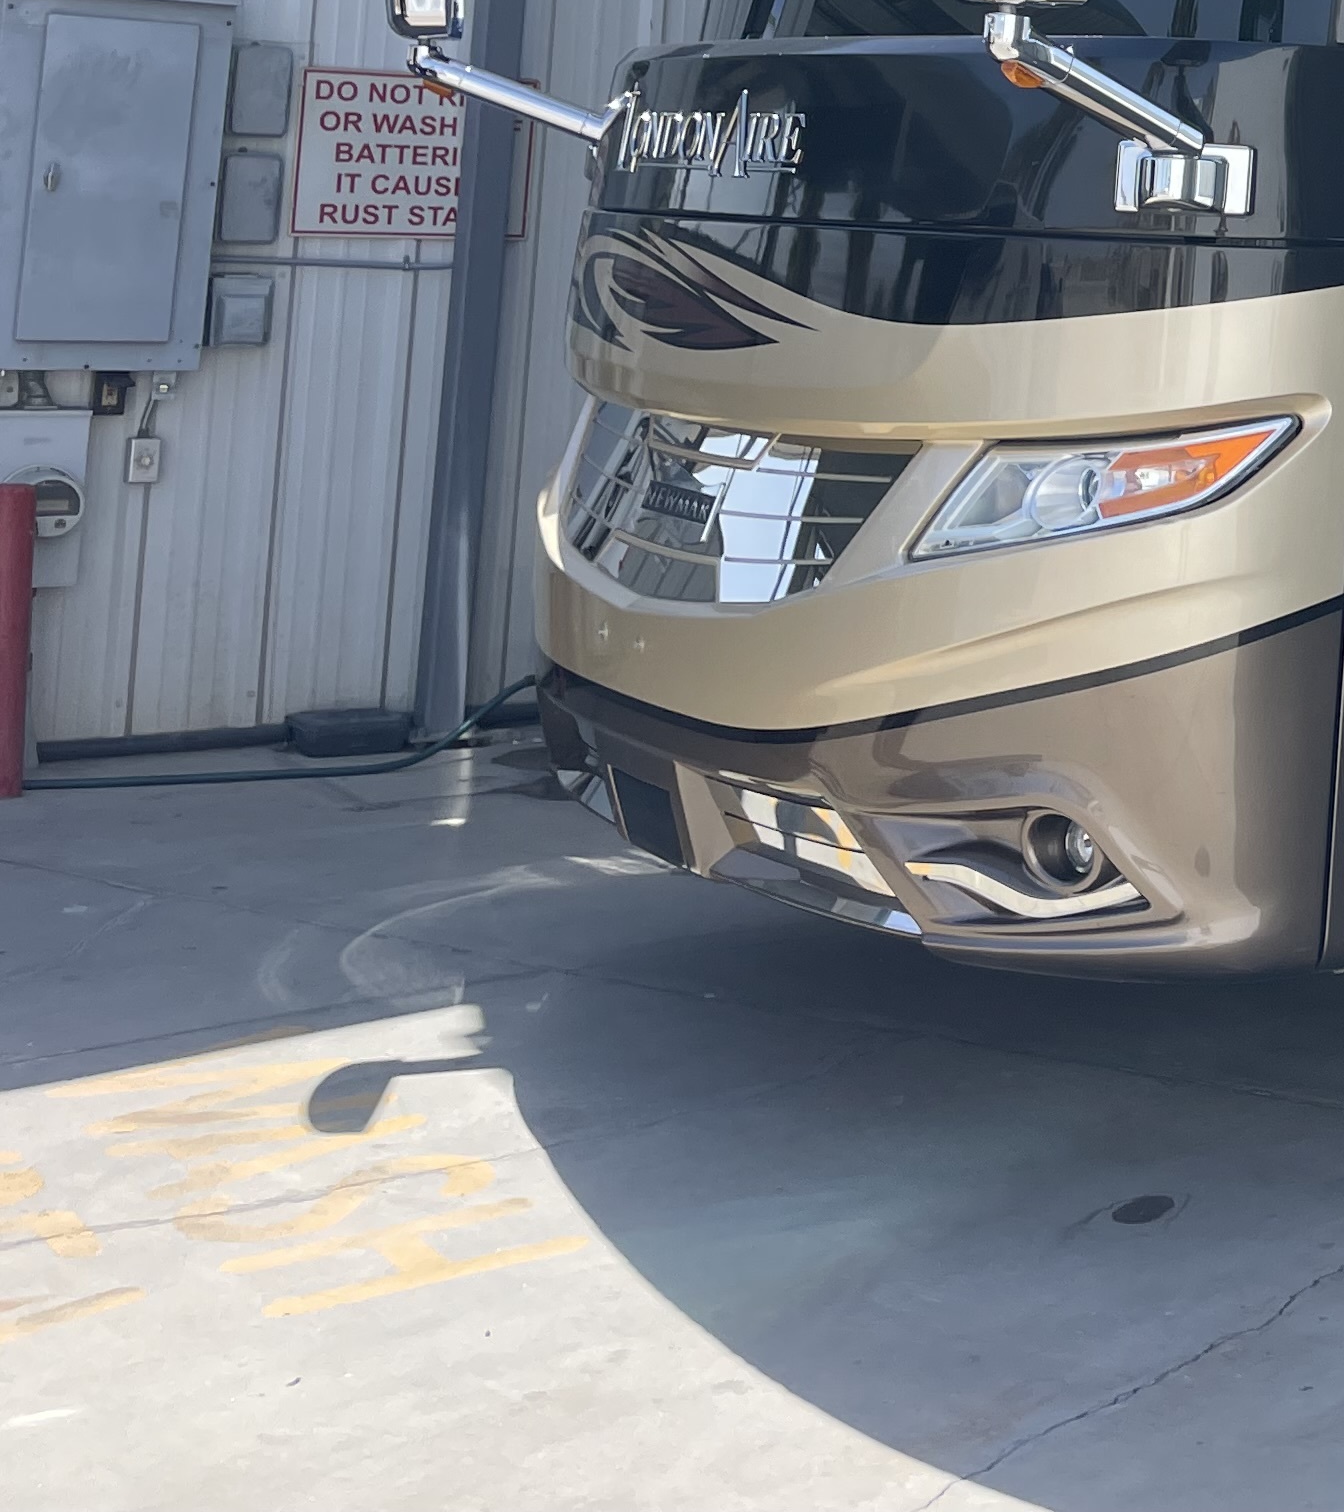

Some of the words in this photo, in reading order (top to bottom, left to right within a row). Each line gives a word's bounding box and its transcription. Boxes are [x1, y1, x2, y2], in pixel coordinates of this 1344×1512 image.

[315, 79, 358, 102] DO
[368, 82, 429, 106] NOT
[319, 110, 363, 134] OR
[373, 113, 458, 138] WASH
[334, 142, 459, 168] BATTERI
[335, 172, 362, 194] IT
[370, 174, 461, 198] CAUS
[318, 202, 400, 226] RUST
[407, 204, 458, 228] STA
